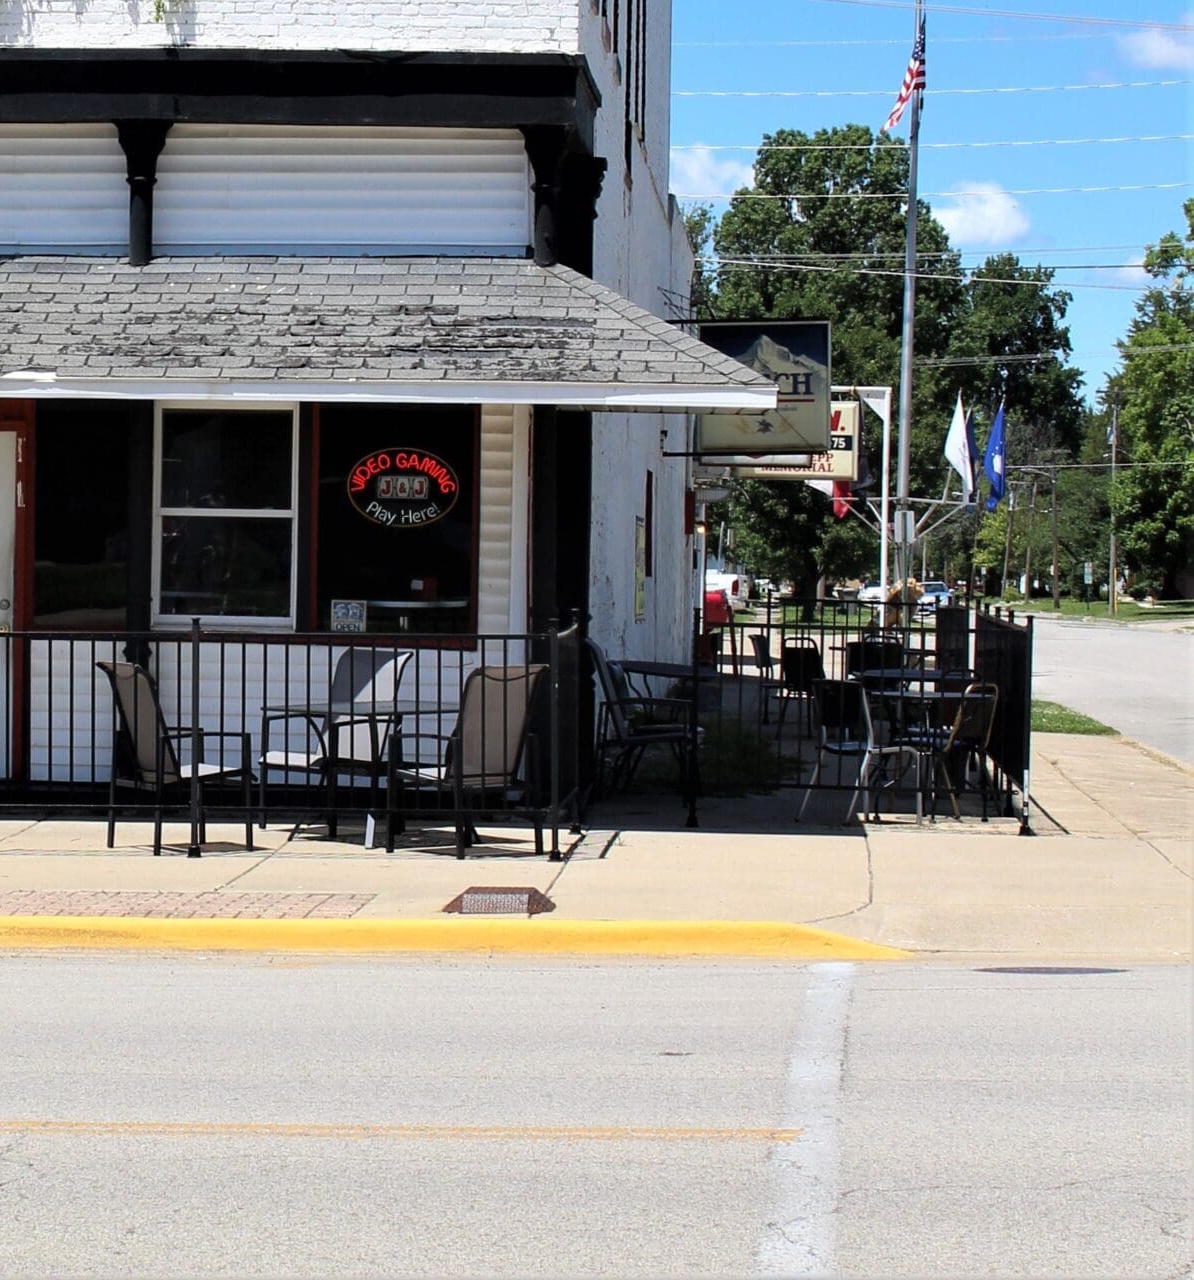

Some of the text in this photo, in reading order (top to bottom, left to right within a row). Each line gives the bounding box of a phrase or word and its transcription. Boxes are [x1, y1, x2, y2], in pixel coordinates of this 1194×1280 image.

[350, 453, 456, 493] VIDEO GAMING
[381, 480, 392, 496] J
[414, 480, 425, 496] J
[366, 501, 441, 526] Play Here!
